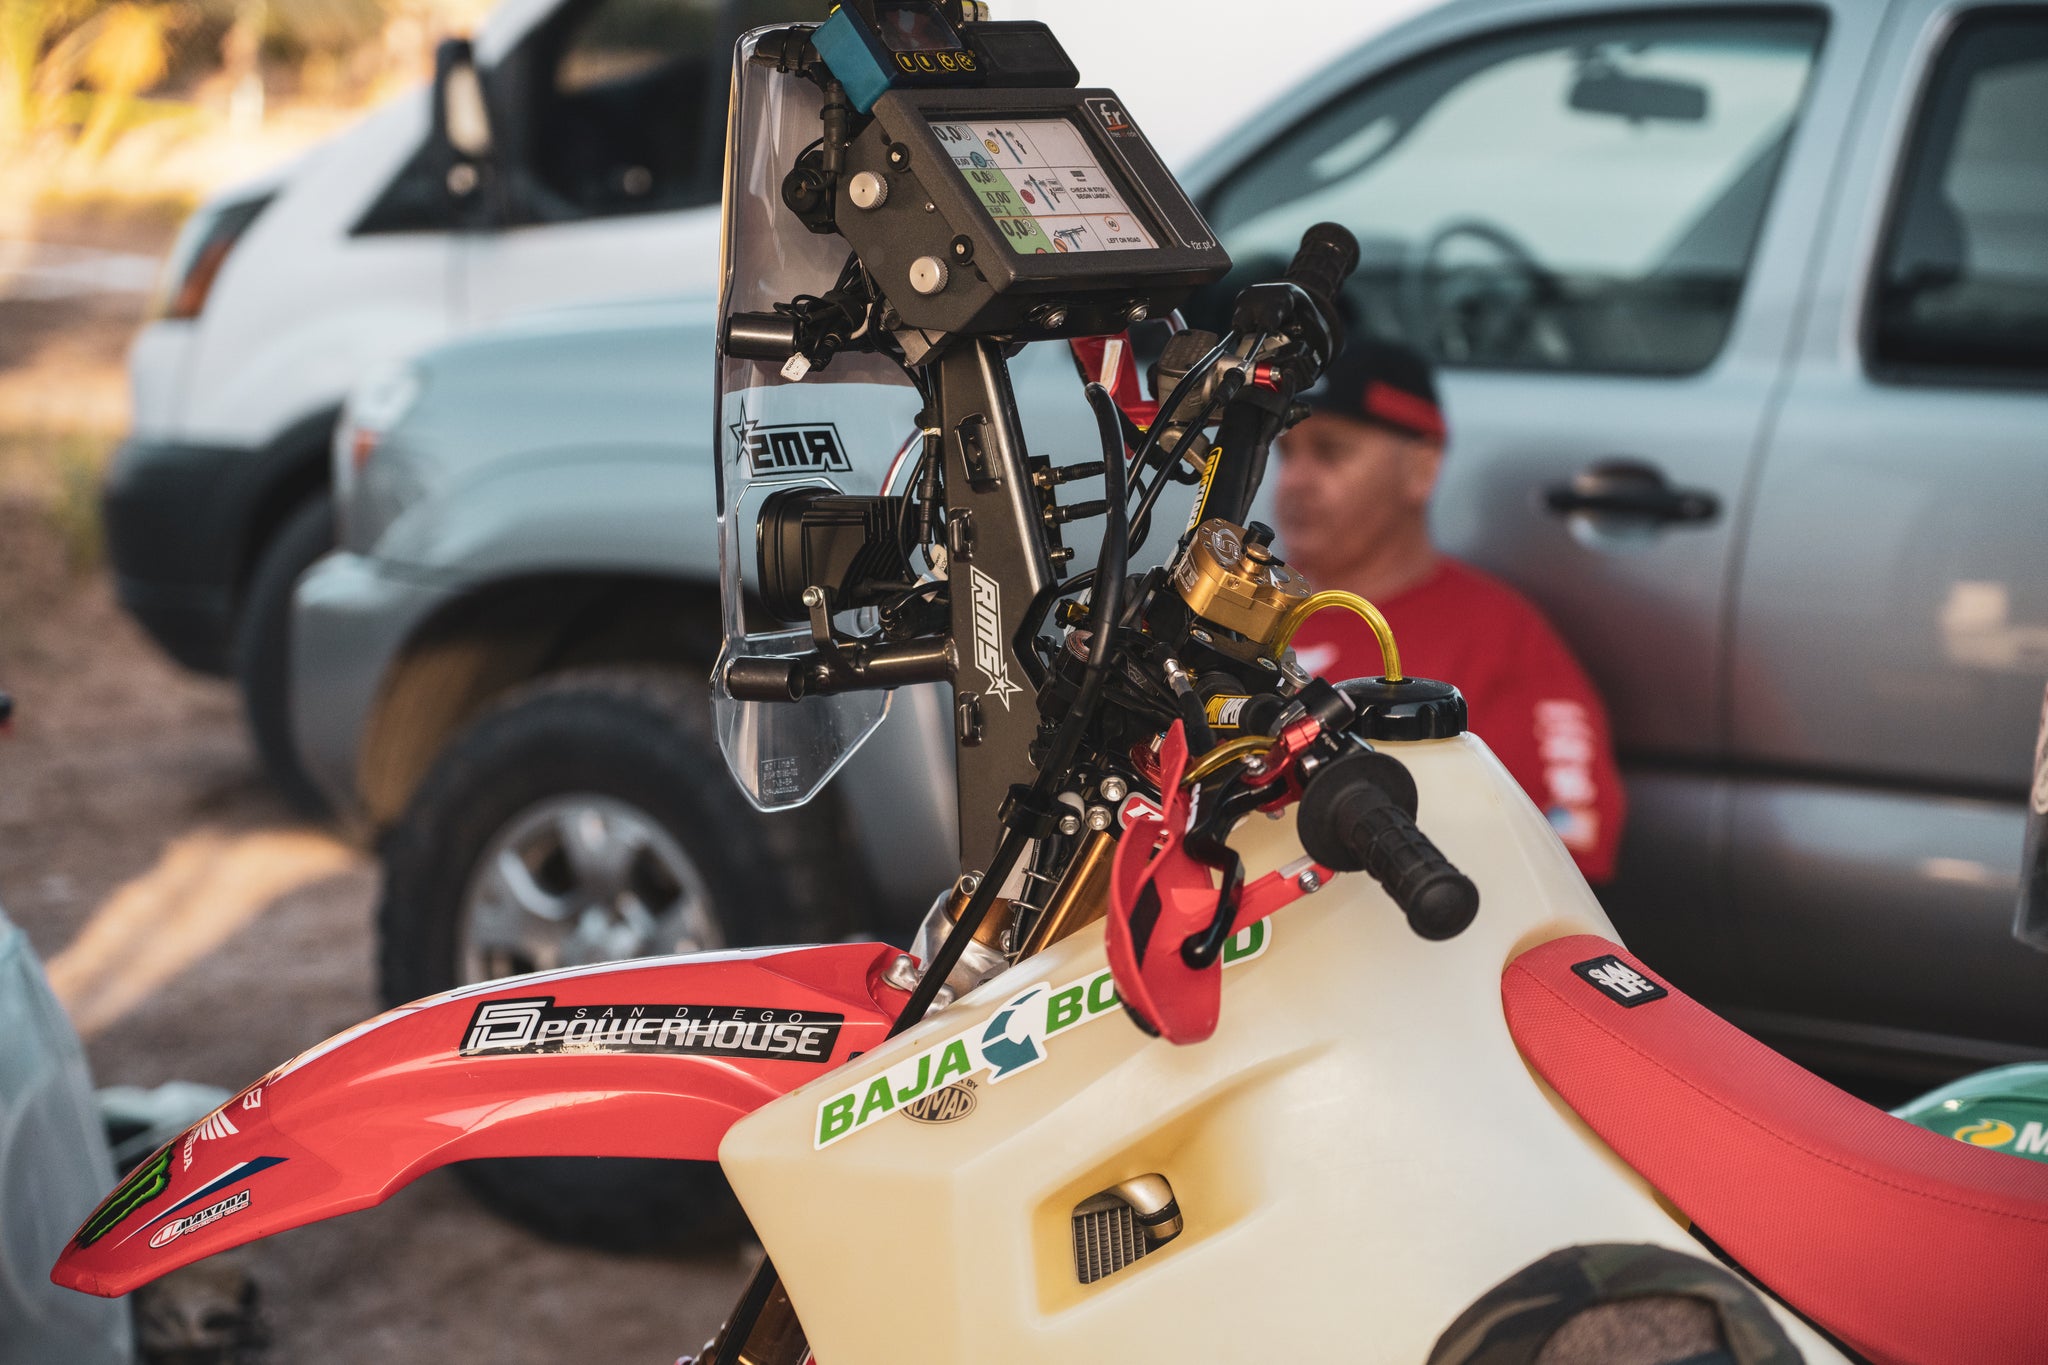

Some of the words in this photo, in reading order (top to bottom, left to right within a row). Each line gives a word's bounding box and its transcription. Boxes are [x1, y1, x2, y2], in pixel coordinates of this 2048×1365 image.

[974, 571, 1000, 677] RMS
[574, 1007, 646, 1018] SAN
[676, 1007, 804, 1024] DIEGO
[819, 1038, 972, 1145] BAJA
[1045, 918, 1265, 1035] BOD
[536, 1017, 831, 1056] POWERHOUSE
[906, 1087, 973, 1120] OMAD
[966, 1078, 979, 1091] BY
[175, 1189, 250, 1232] MAXIMA
